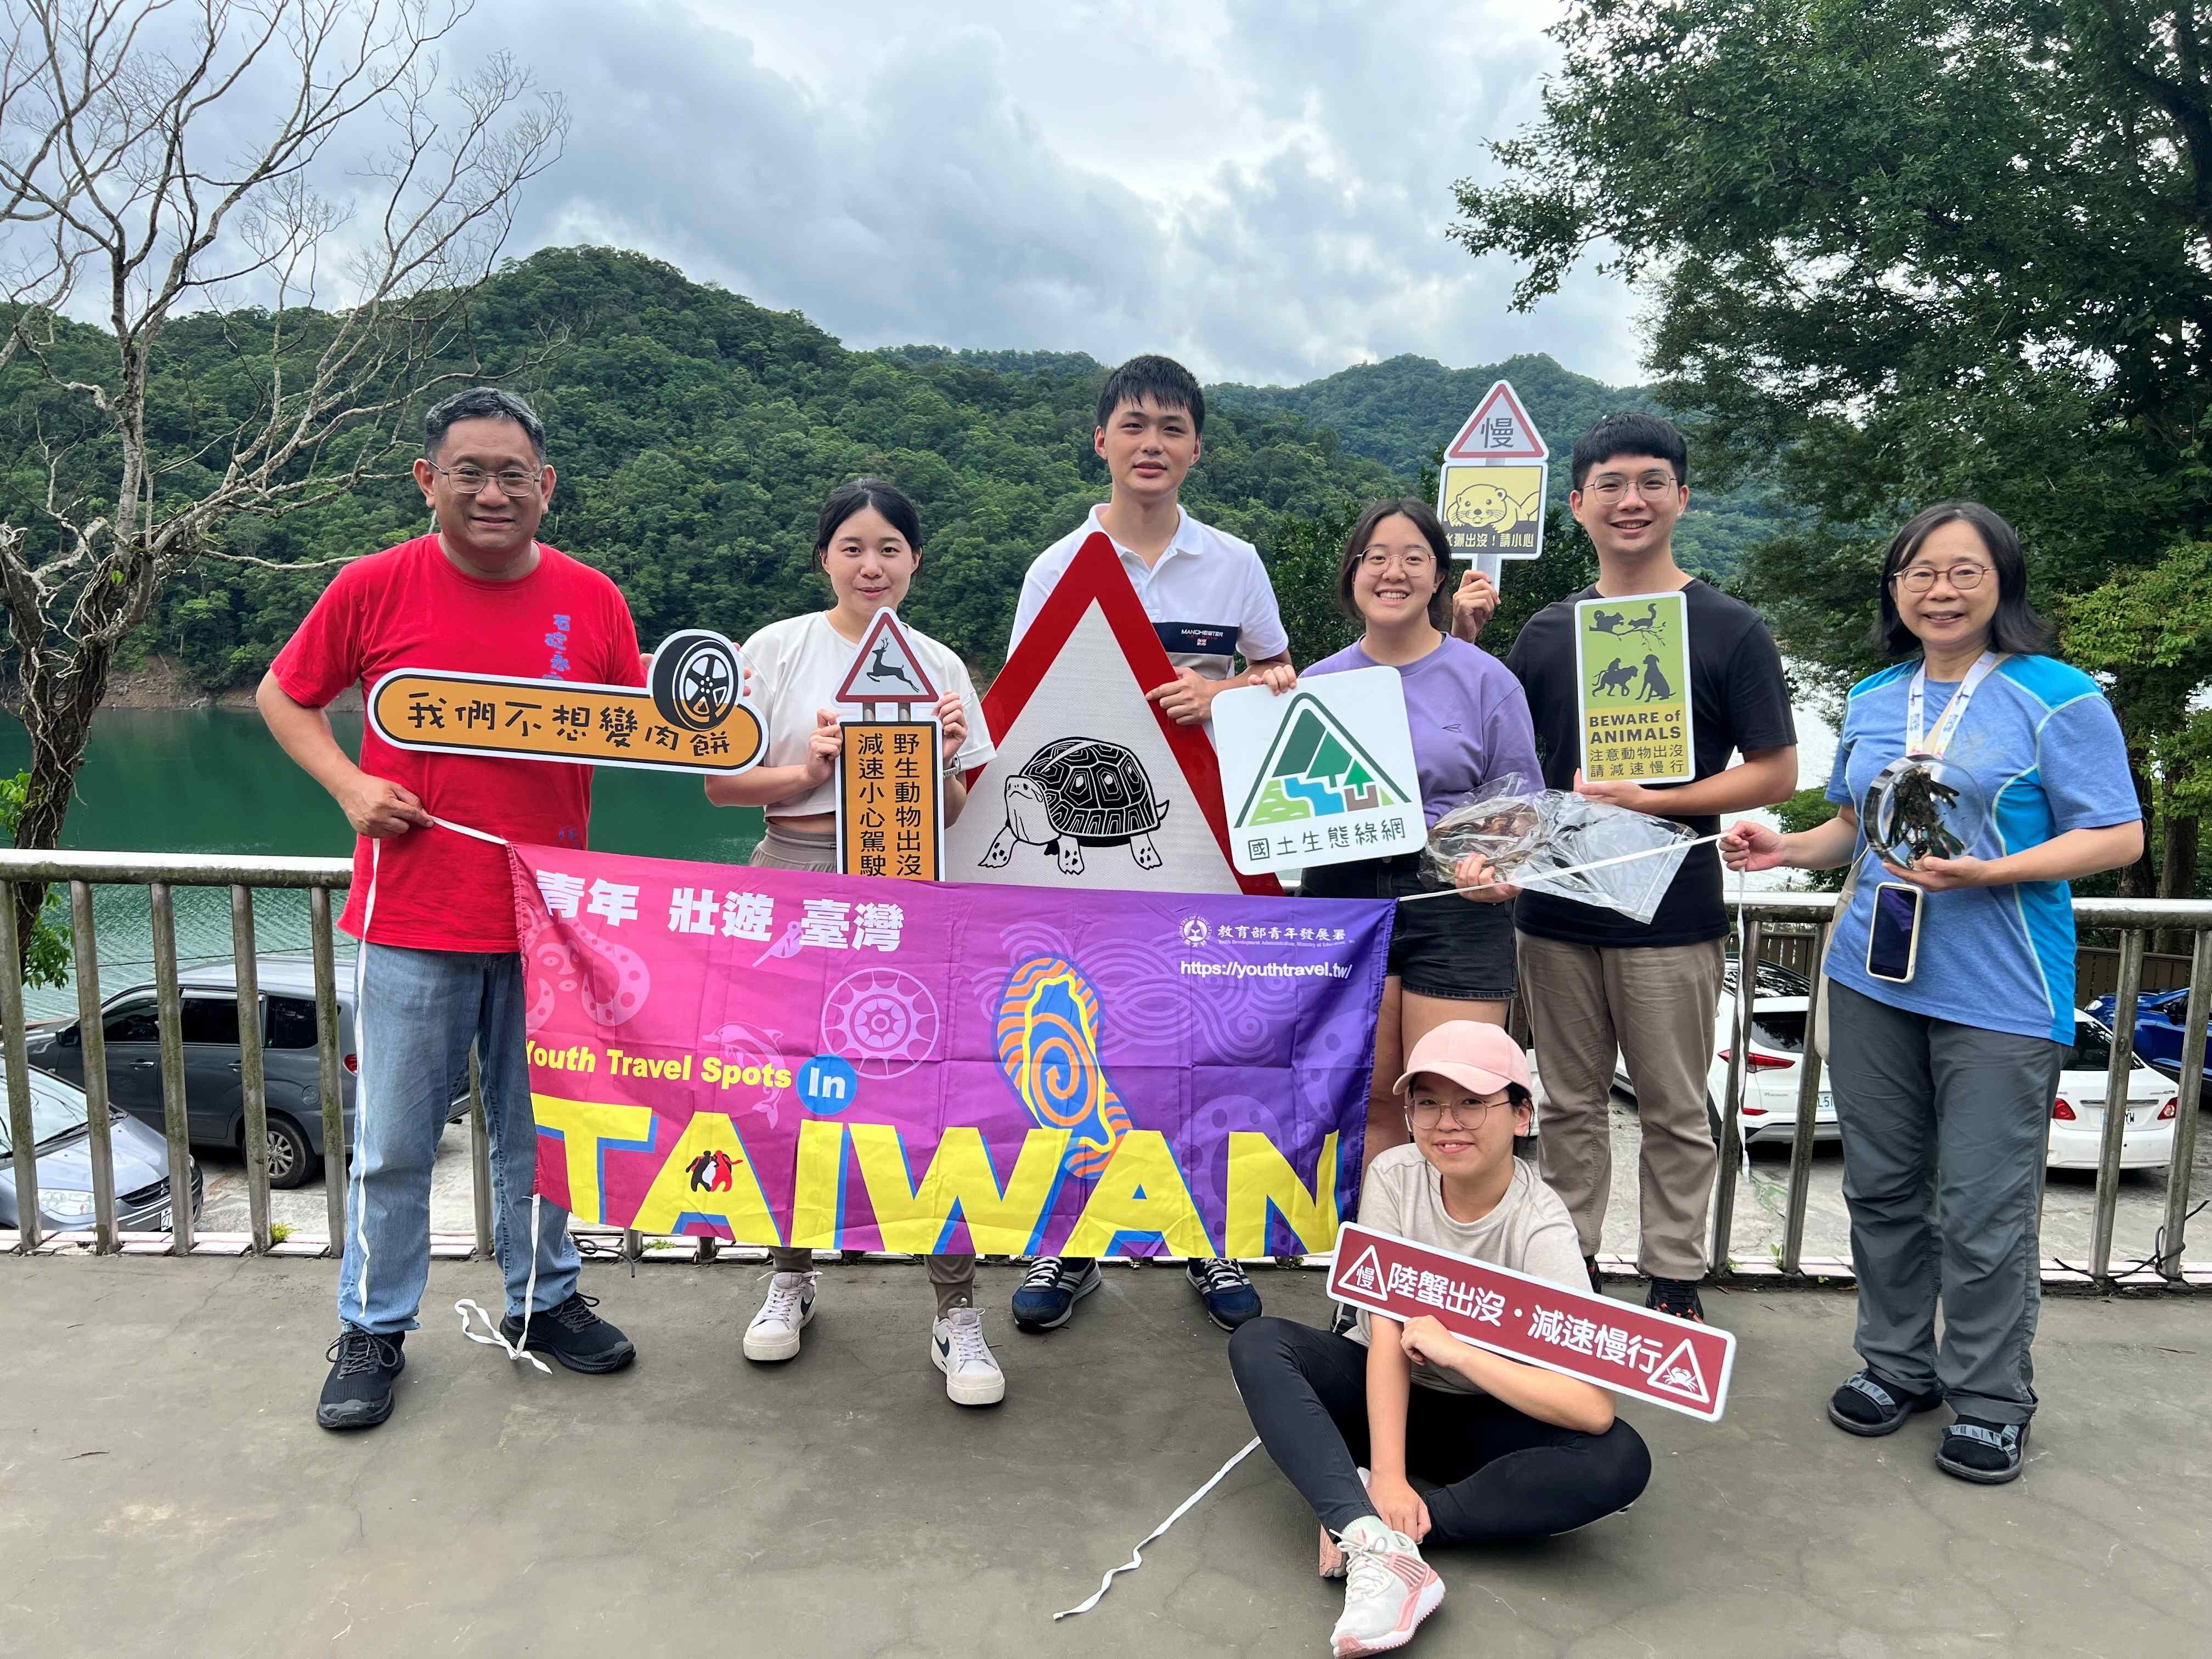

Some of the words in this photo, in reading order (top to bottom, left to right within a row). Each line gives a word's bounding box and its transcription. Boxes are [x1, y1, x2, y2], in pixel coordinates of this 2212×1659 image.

[1480, 417, 1514, 448] 慢
[407, 692, 731, 757] 我們不想變肉餅
[1589, 712, 1659, 727] BEWARE
[1664, 710, 1681, 722] of
[1590, 726, 1681, 744] ANIMALS
[1589, 744, 1683, 762] 注意動物出沒
[1590, 760, 1684, 778] 請減速慢行
[857, 733, 886, 877] 減速小心駕駛
[893, 733, 922, 877] 野生動物出沒
[1248, 817, 1406, 861] 國土生態綠網
[535, 869, 640, 927] 青年
[667, 887, 775, 942] 壯遊
[798, 898, 905, 952] 臺灣
[1217, 924, 1346, 941] 教育部青年發展署
[1181, 961, 1352, 979] https://youthtravel.tw/
[526, 1040, 596, 1073] Youth
[606, 1048, 691, 1082] Travel
[701, 1057, 793, 1090] Spots
[808, 1067, 846, 1100] In
[531, 1092, 1340, 1257] TAIWAN
[1355, 1264, 1375, 1291] 慢
